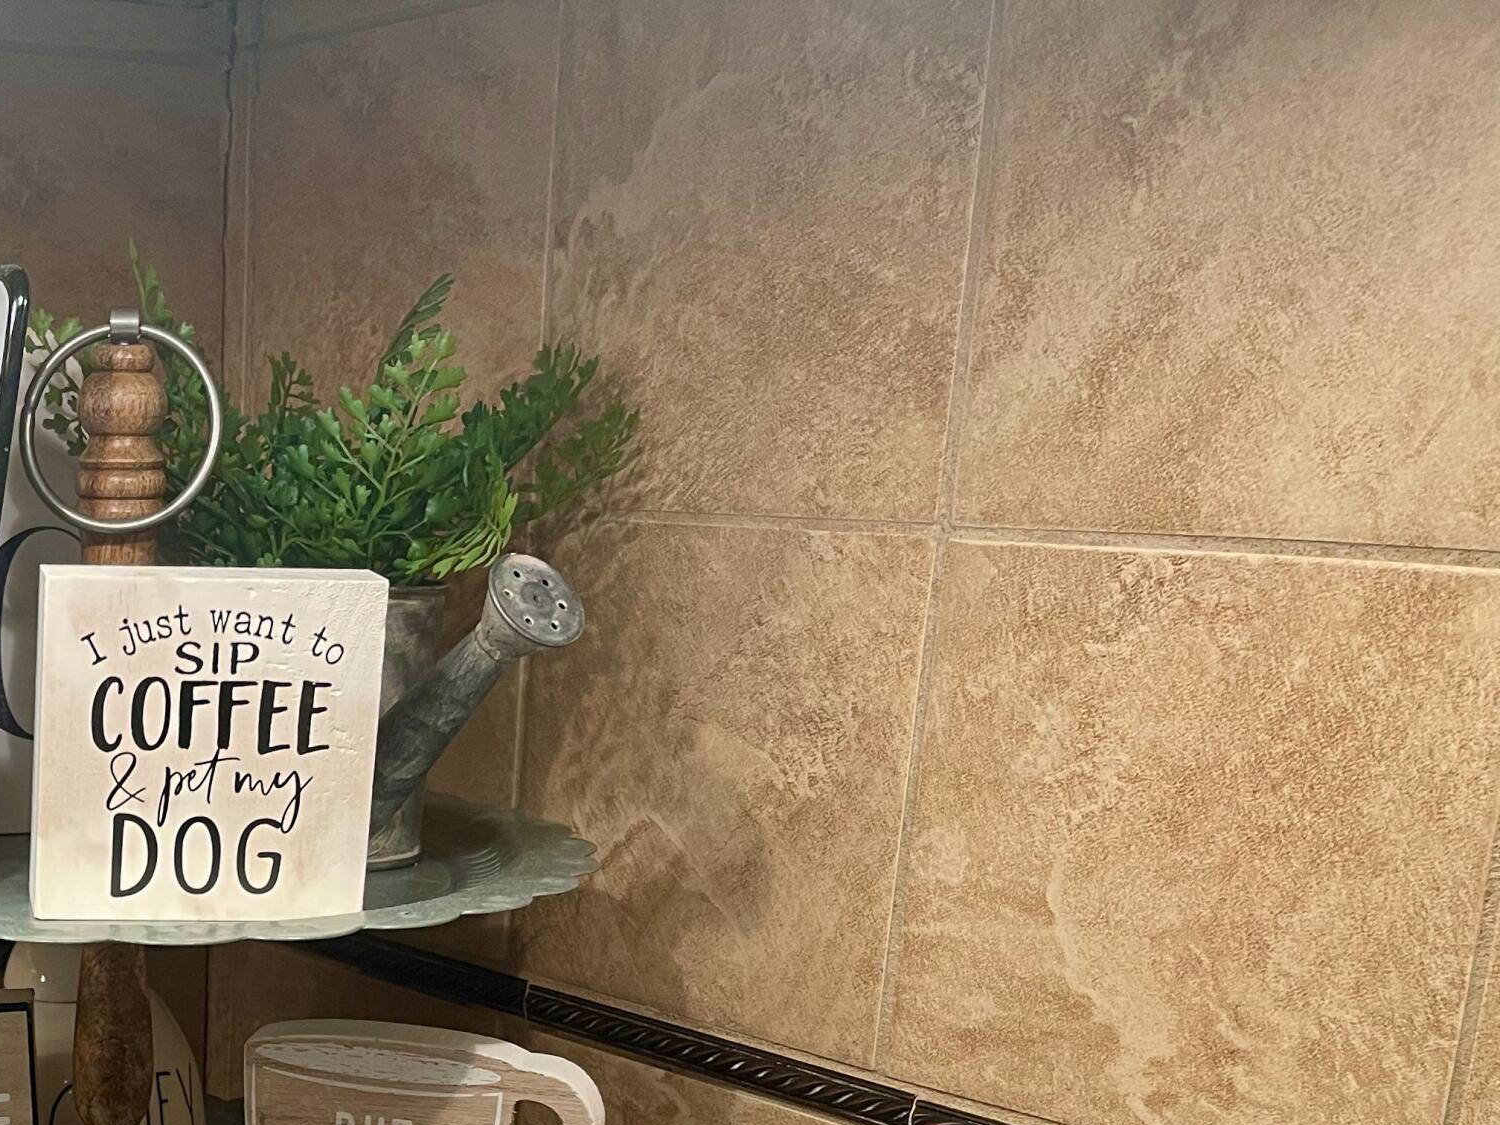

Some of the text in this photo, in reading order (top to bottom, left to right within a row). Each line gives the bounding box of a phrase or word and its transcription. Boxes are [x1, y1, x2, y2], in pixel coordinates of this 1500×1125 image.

[80, 604, 345, 666] I just want to
[174, 641, 260, 675] SIP
[90, 676, 333, 755] COFFEE
[105, 748, 314, 834] & pet my
[109, 813, 283, 898] DOG
